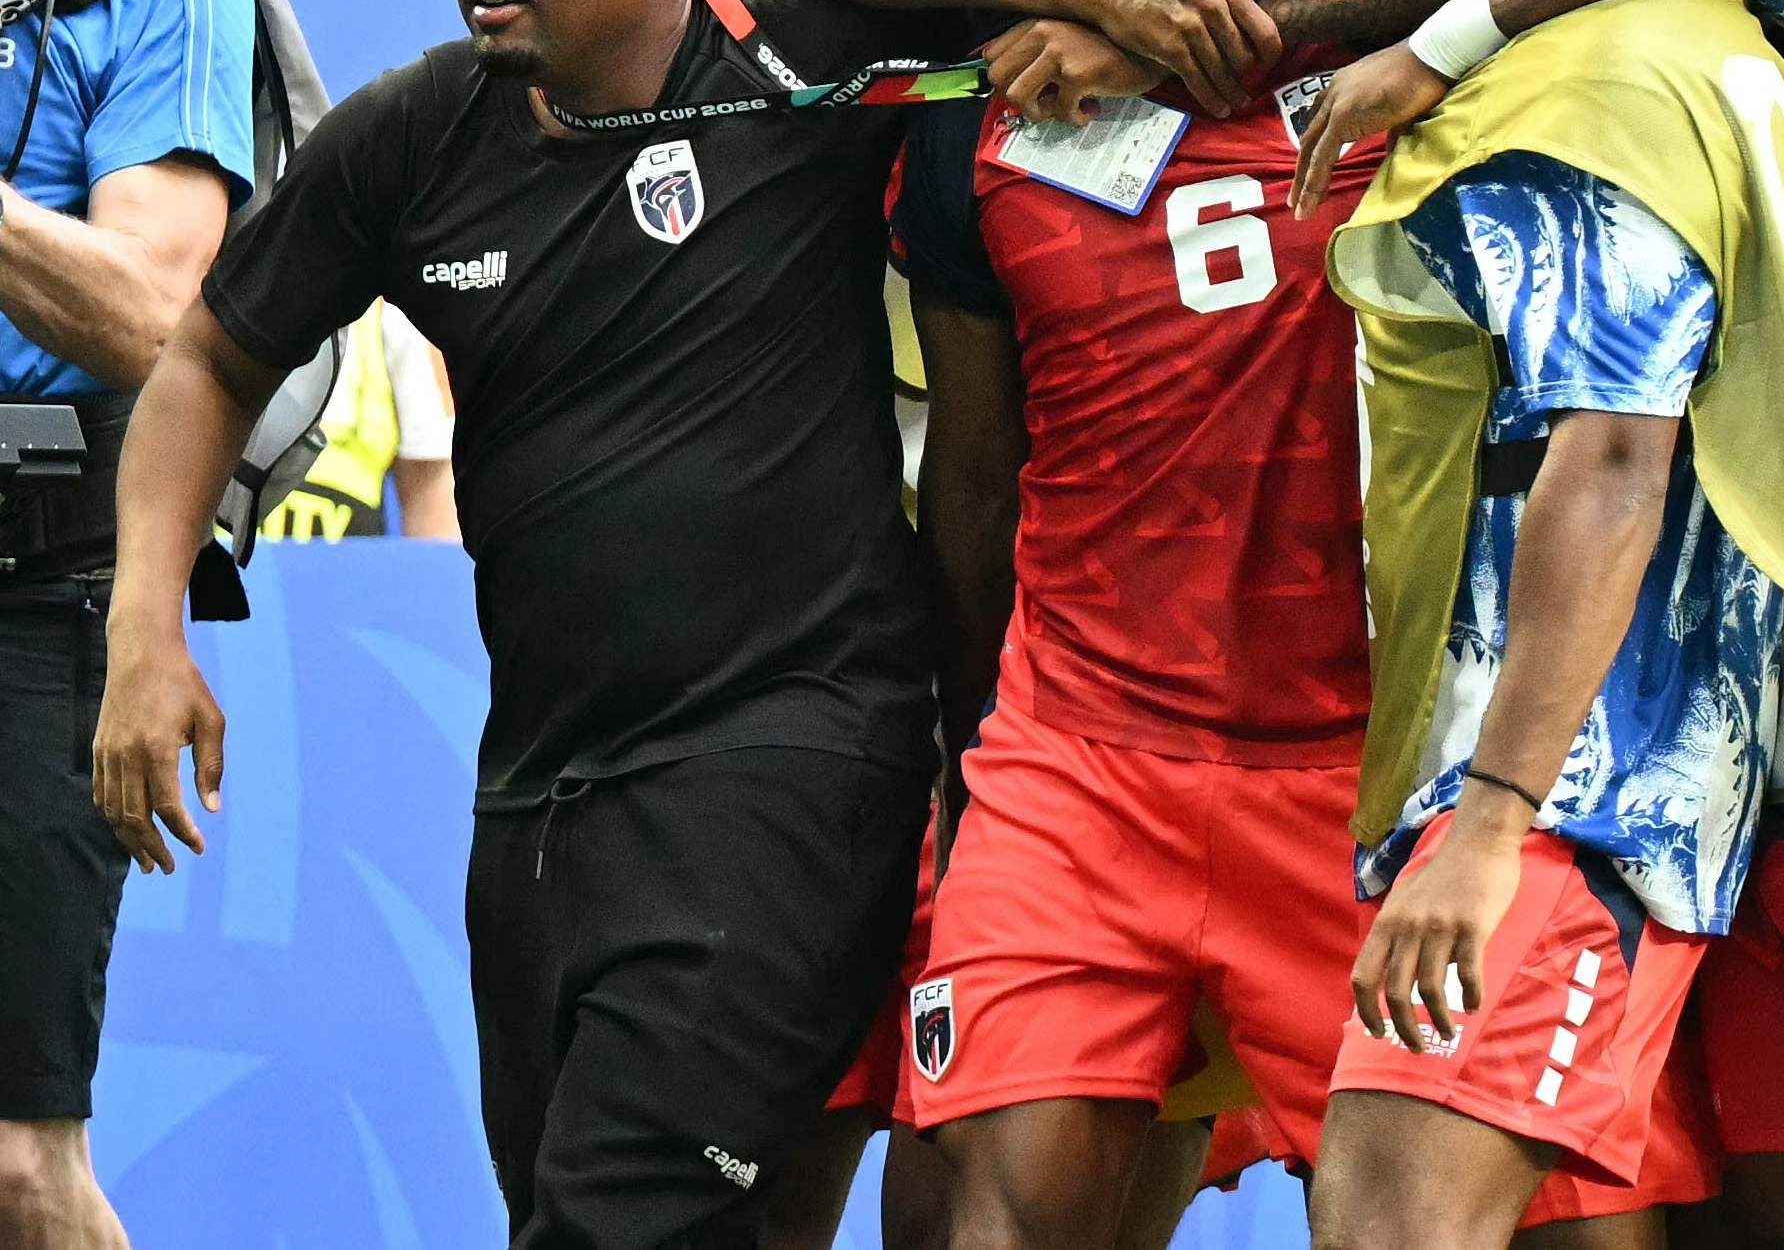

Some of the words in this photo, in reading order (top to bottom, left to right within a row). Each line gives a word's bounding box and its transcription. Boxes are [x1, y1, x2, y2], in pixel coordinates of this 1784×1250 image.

[1281, 71, 1336, 107] FCF
[553, 103, 587, 129] FIFA
[587, 111, 656, 130] WORLD
[659, 106, 698, 123] CUP
[699, 98, 769, 118] 2026
[1165, 173, 1278, 315] 6
[422, 250, 508, 289] capelli
[458, 276, 506, 291] SPORT
[914, 983, 949, 1007] FCF
[703, 1145, 759, 1185] capelli
